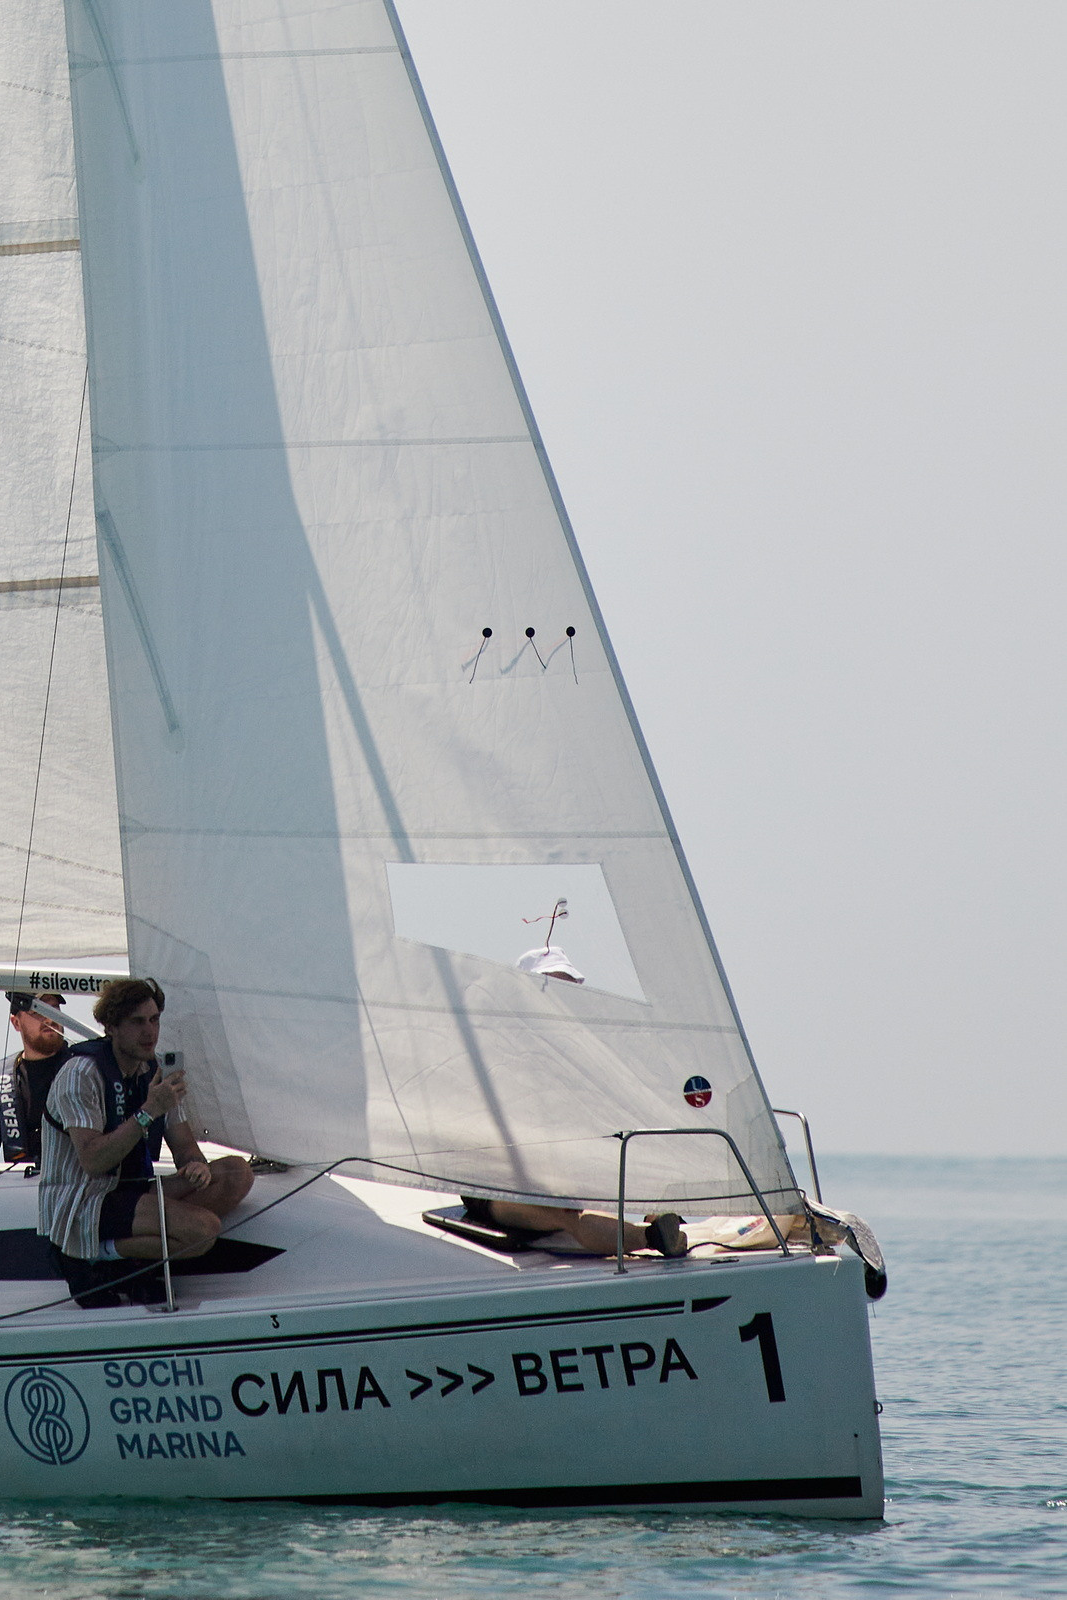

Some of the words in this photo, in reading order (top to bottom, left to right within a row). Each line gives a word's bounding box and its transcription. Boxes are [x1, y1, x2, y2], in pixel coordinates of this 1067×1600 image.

[738, 1312, 786, 1403] 1
[103, 1358, 205, 1388] SOCHI
[231, 1366, 391, 1417] СИЛА
[511, 1338, 698, 1397] ВЕТРА
[110, 1395, 223, 1424] GRAND
[116, 1431, 246, 1460] MARINA
